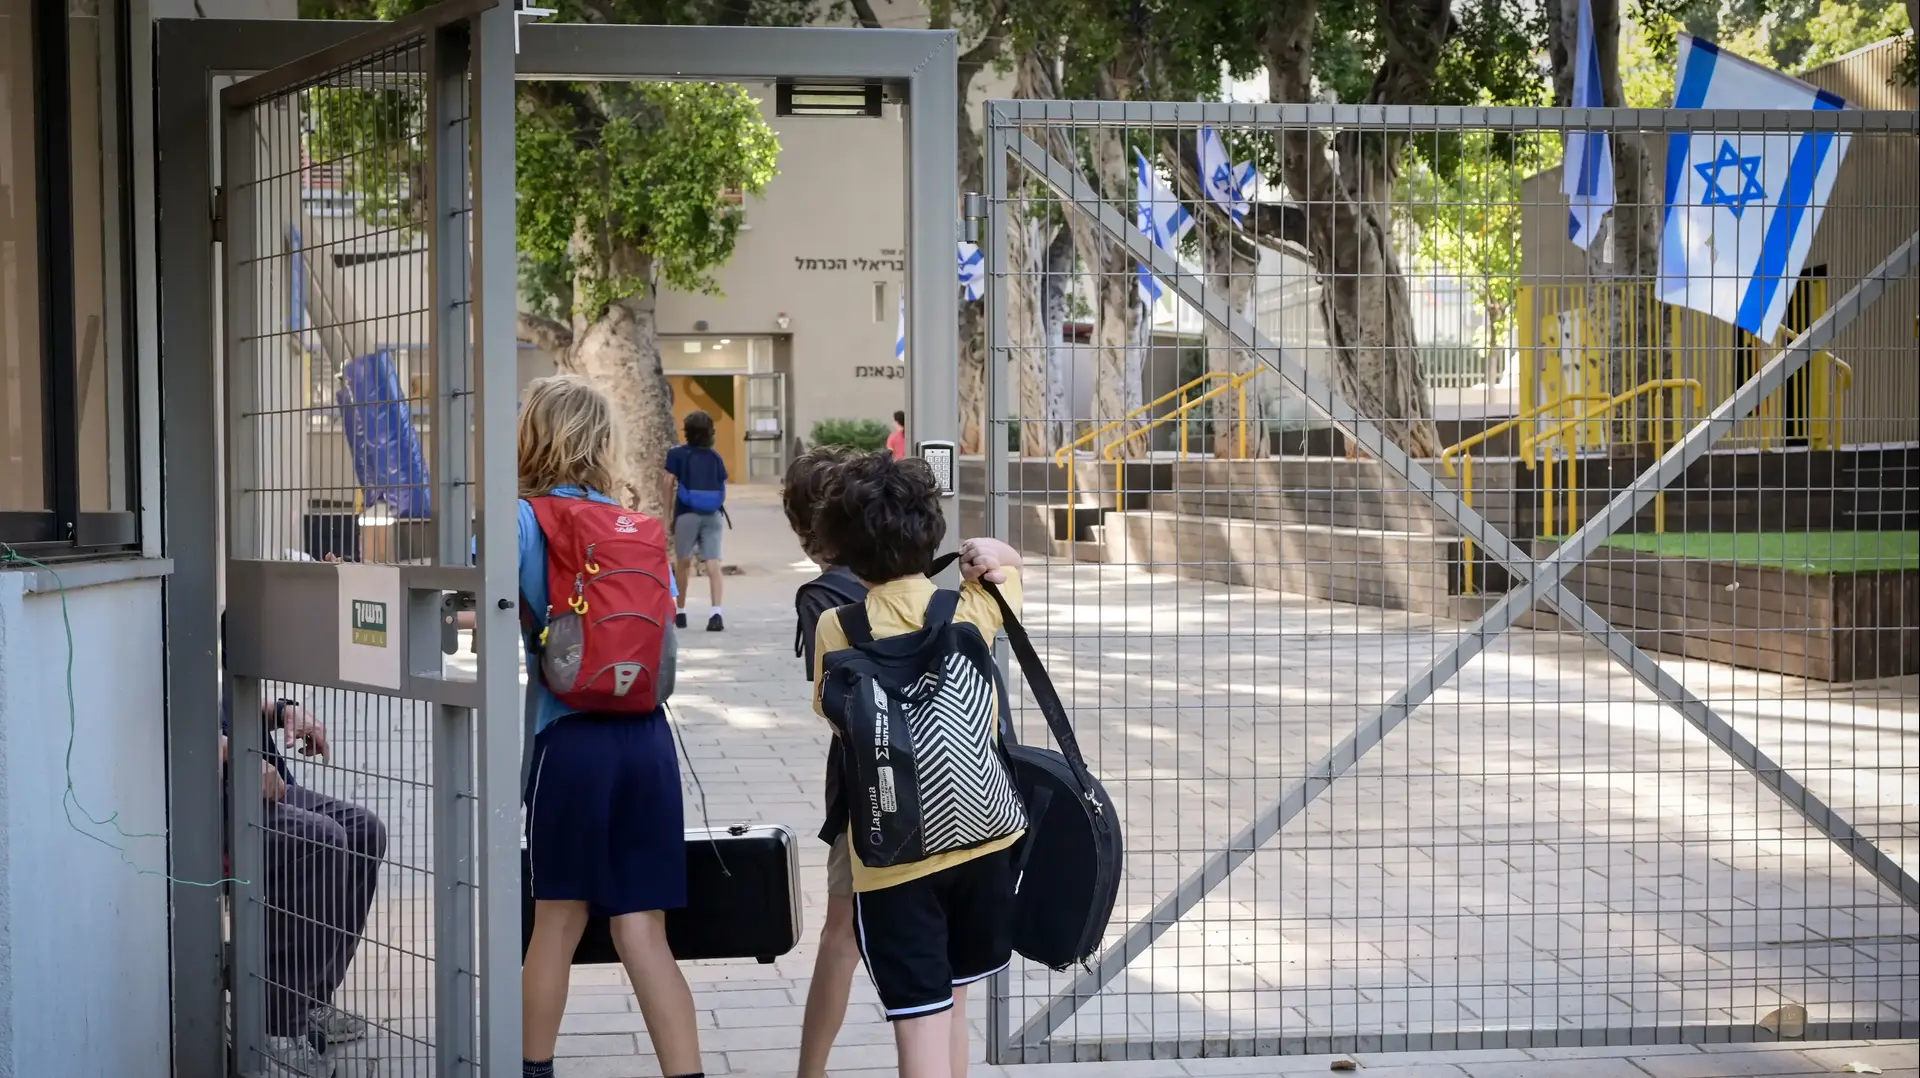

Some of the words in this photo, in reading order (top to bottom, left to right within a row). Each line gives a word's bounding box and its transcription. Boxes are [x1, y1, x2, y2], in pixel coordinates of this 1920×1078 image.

[795, 256, 848, 270] הכרמל
[852, 257, 905, 271] בריאלי
[355, 602, 384, 628] משוך
[355, 631, 384, 645] PULL
[868, 786, 882, 832] Laguna
